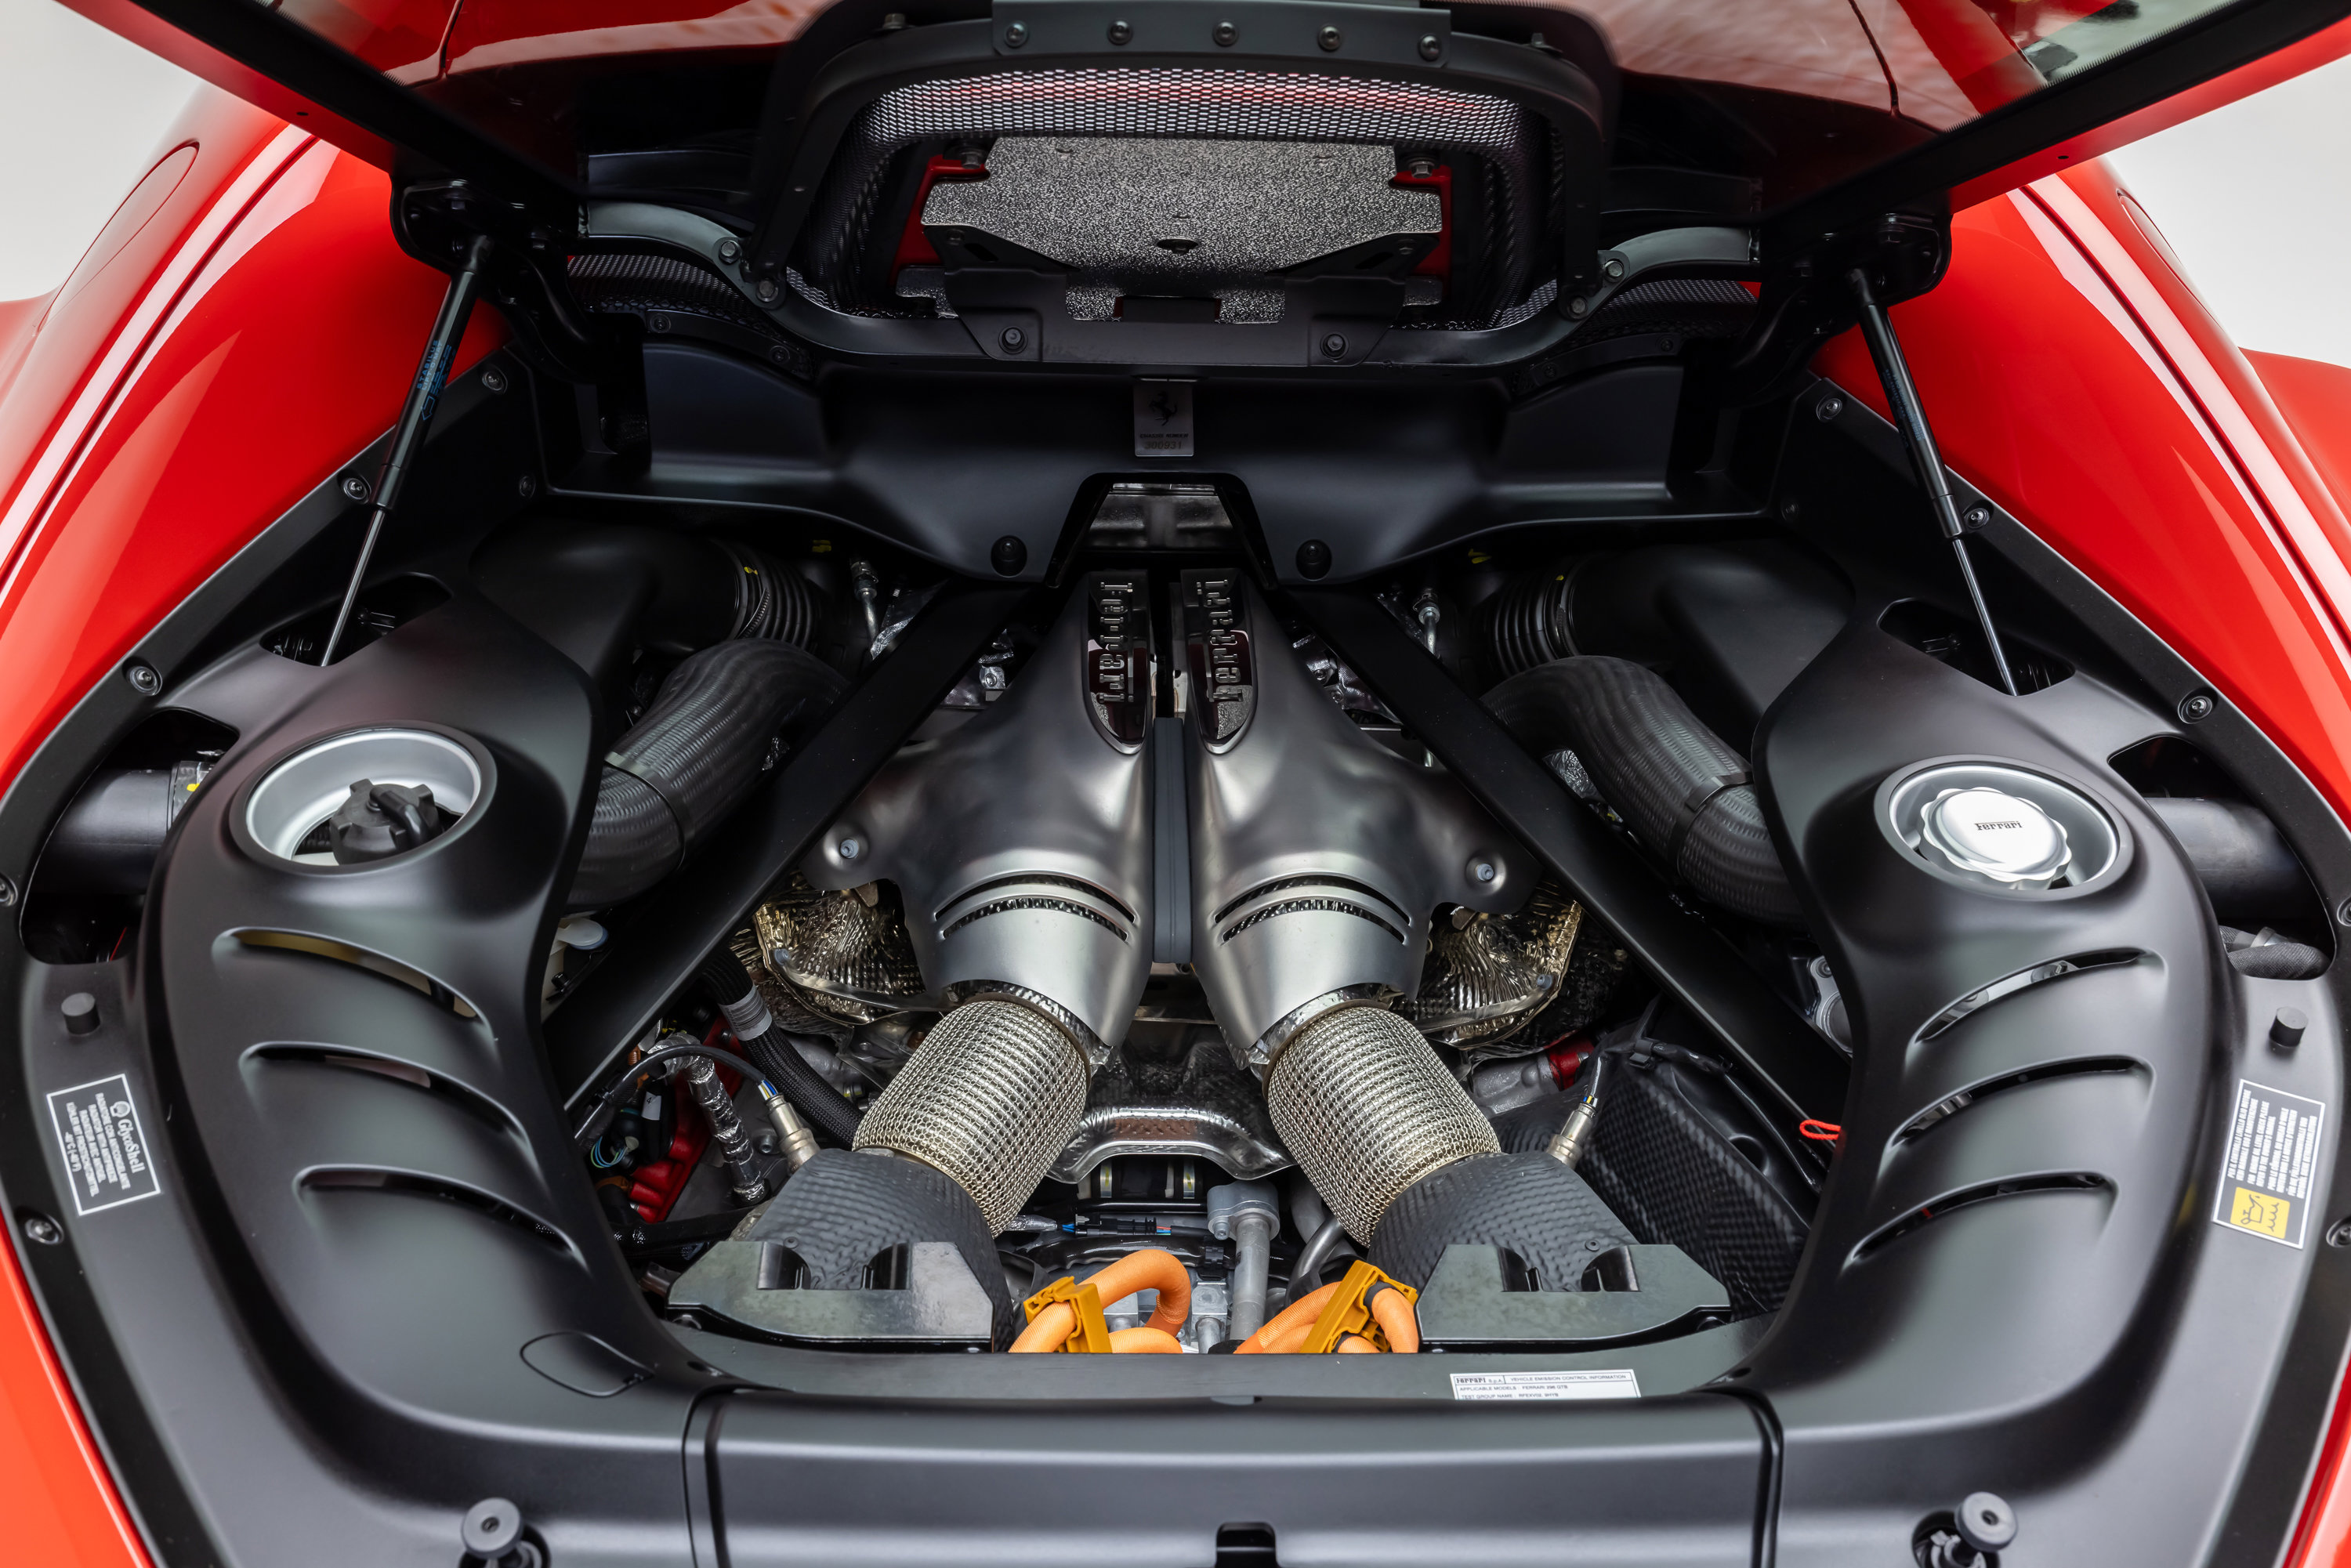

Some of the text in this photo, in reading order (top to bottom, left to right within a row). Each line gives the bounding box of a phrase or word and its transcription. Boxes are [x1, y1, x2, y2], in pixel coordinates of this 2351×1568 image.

[417, 339, 438, 389] STABILUS
[1144, 440, 1183, 450] 300931
[1099, 581, 1135, 703] Ferrari
[1196, 579, 1244, 703] Ferrari
[1975, 820, 2022, 831] Ferrari
[89, 1104, 103, 1133] RADIATOR
[118, 1119, 144, 1172] GlycoShell
[2254, 1134, 2263, 1148] LEVEL
